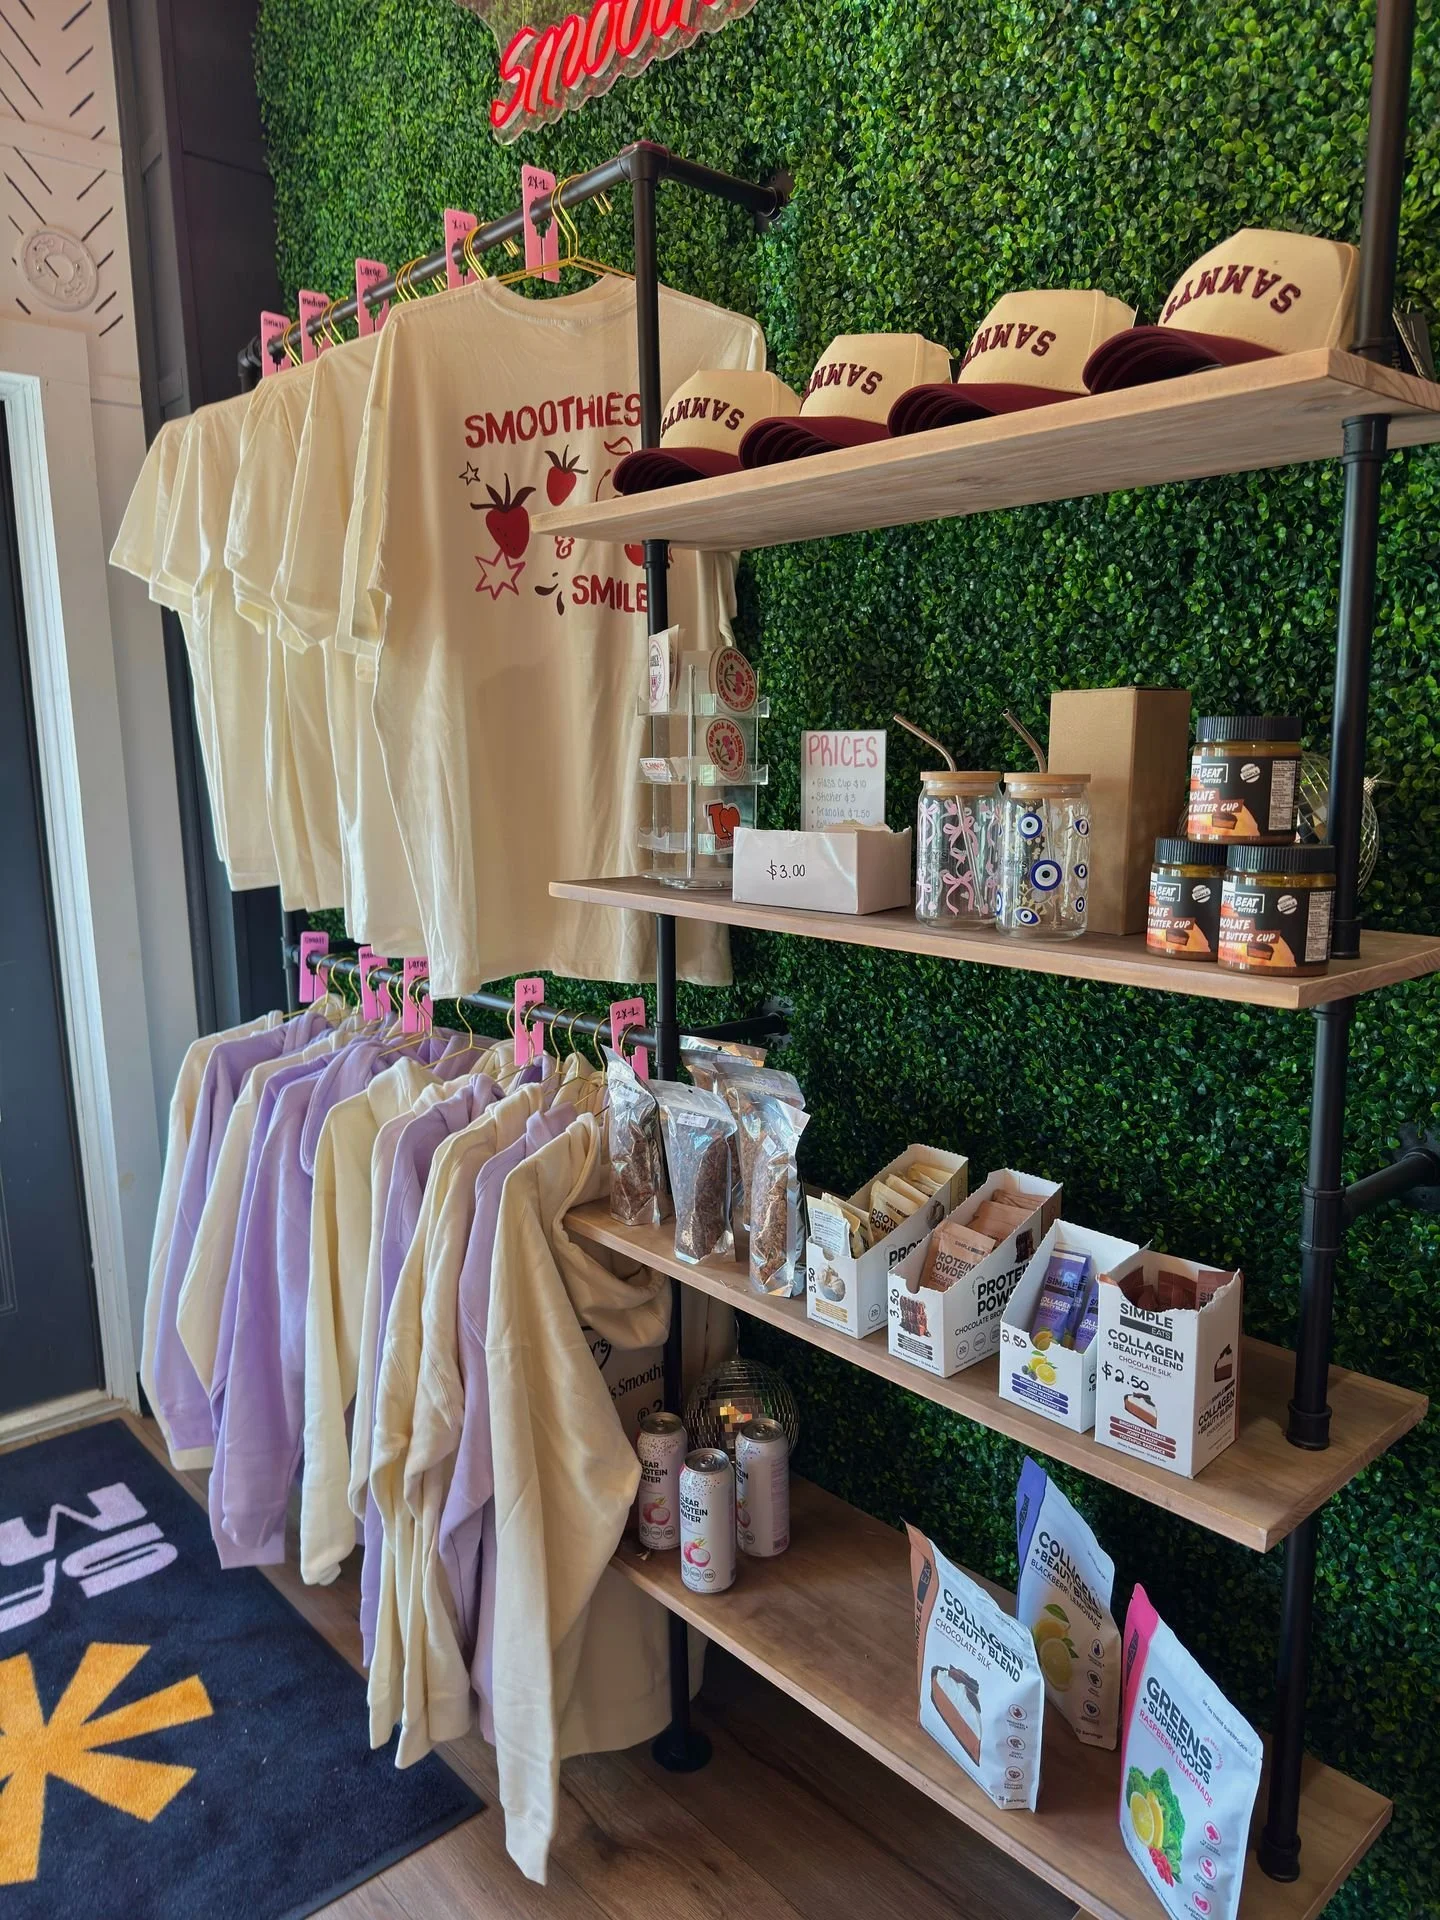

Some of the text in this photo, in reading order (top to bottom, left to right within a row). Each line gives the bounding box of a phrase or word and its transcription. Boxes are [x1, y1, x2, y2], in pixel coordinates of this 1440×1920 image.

[360, 265, 382, 282] Large
[464, 391, 641, 448] SMOOTHIES
[808, 734, 879, 769] PRICES
[837, 778, 851, 790] Cup
[1201, 767, 1224, 778] BEAT
[816, 806, 845, 818] Granola
[1220, 802, 1239, 812] CUP
[766, 860, 806, 880] $3.00
[1157, 886, 1177, 896] BEAT
[1235, 896, 1260, 908] BEAT
[1174, 920, 1191, 930] CUP
[1225, 931, 1276, 943] BUTTER CUP
[408, 959, 428, 973] Large
[808, 1267, 817, 1293] 3.50
[889, 1288, 900, 1319] 3.50
[954, 1314, 989, 1337] CHOCOLATE
[1120, 1303, 1174, 1330] SIMPLE
[1001, 1329, 1028, 1349] 2.50
[1151, 1327, 1172, 1340] EATS
[1107, 1328, 1184, 1364] COLLAGEN
[1118, 1355, 1172, 1378] CHOCOLATE SILK
[1152, 1354, 1183, 1372] BLEND
[1101, 1361, 1149, 1392] $2.50
[1198, 1387, 1235, 1427] COLLAGEN
[1030, 1558, 1070, 1596] BLACKBERRY
[1069, 1594, 1102, 1631] LEMONADE
[943, 1588, 1024, 1671] COLLAGEN
[935, 1617, 977, 1657] CHOCOLATE
[976, 1653, 992, 1671] SILK
[988, 1645, 1021, 1683] BLEND
[1146, 1676, 1213, 1771] GREENS
[1140, 1709, 1176, 1756] RASPBERRY
[1175, 1756, 1214, 1808] LEMONADE
